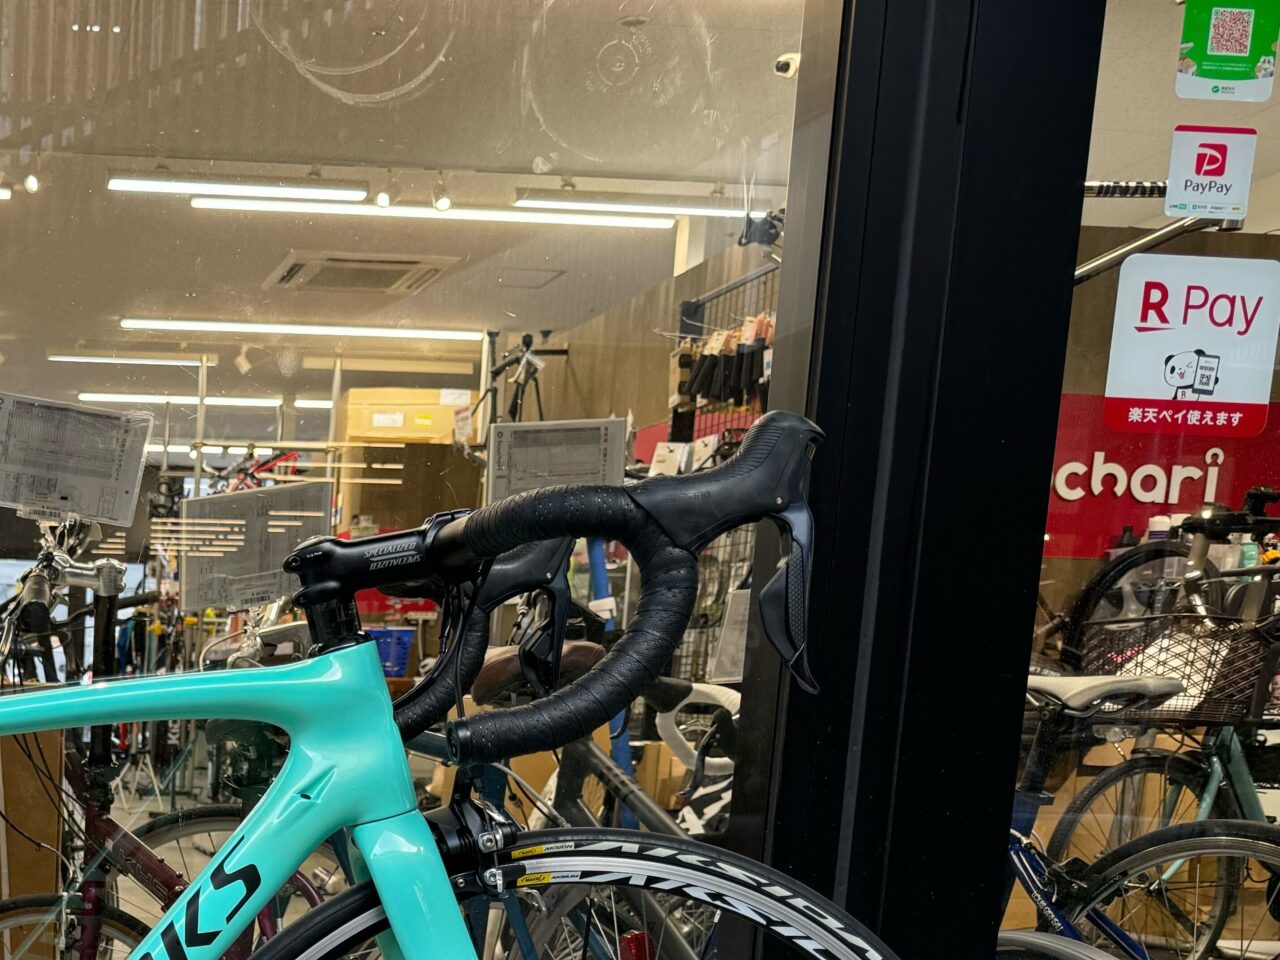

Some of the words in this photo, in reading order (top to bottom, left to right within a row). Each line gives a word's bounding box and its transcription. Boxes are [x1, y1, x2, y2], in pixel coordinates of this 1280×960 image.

[1184, 179, 1233, 197] PayPay
[1137, 280, 1173, 330] R
[1182, 285, 1264, 336] Pay
[1127, 406, 1243, 427] 楽天ペイ使えます
[363, 542, 417, 559] SPECIALIZED
[369, 554, 424, 571] SPECIALIZED
